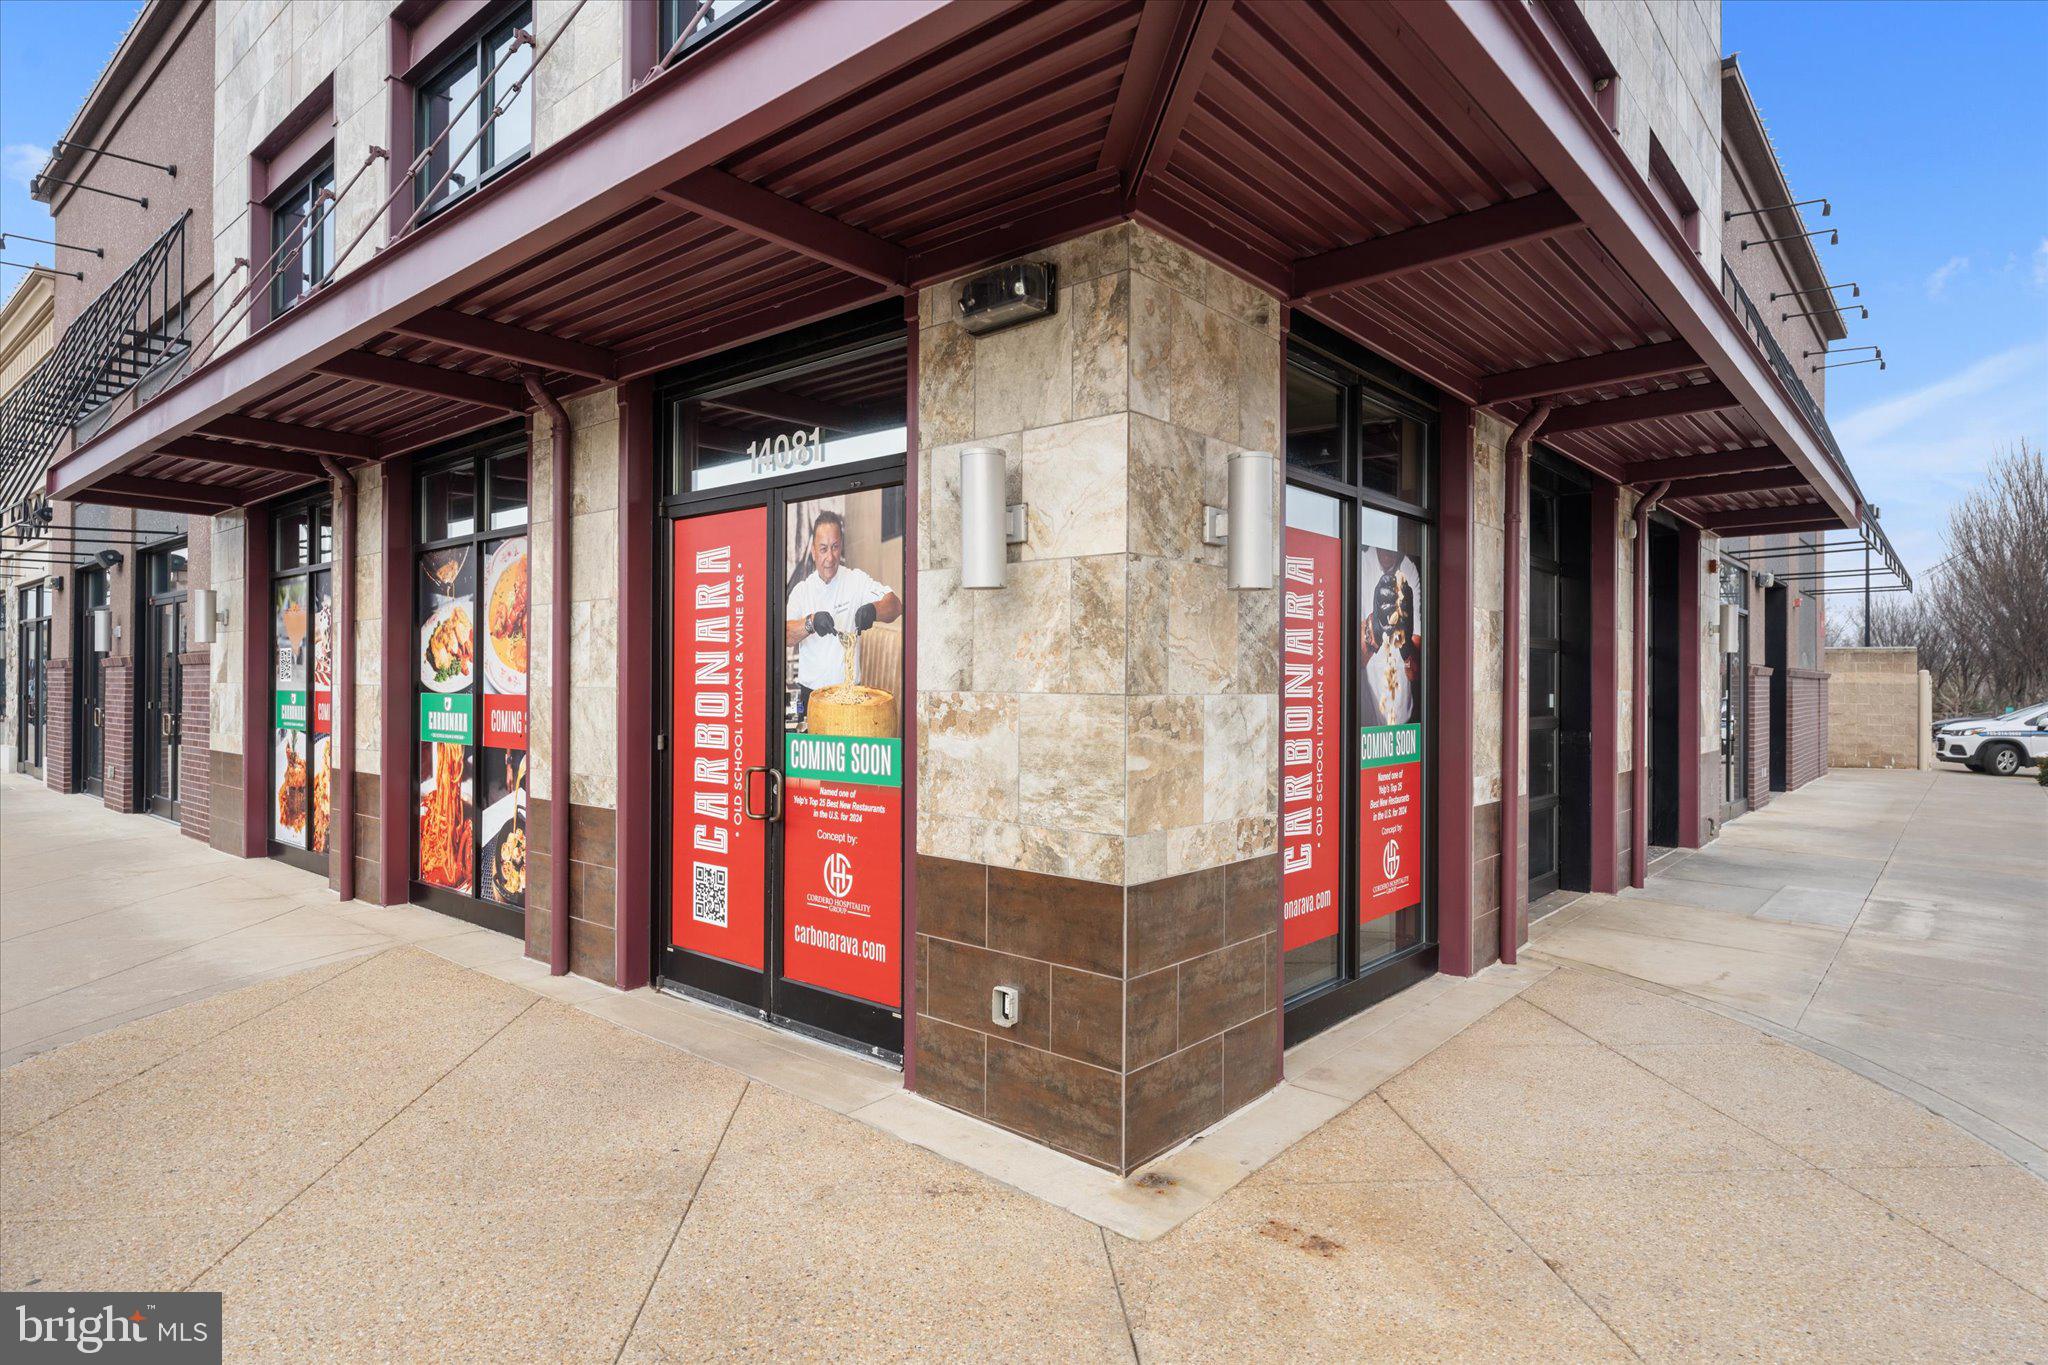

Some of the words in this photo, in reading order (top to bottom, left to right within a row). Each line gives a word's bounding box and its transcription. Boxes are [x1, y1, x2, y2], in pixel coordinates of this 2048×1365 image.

[747, 427, 820, 473] 14081
[736, 574, 744, 602] BAR
[735, 606, 744, 648] WINE
[735, 652, 744, 662] &
[1317, 666, 1324, 676] &
[694, 545, 731, 854] CARBONARA
[734, 668, 744, 722] ITALIAN
[491, 709, 522, 733] COMING
[1284, 555, 1314, 875] CARBONARA
[734, 728, 743, 790] SCHOOL
[791, 739, 845, 772] COMING
[851, 743, 891, 776] SOON
[1361, 732, 1394, 760] COMING
[1396, 730, 1416, 756] SOON
[793, 795, 808, 806] Yelp's
[809, 797, 818, 807] Top
[819, 799, 826, 807] 25
[826, 799, 839, 809] Best
[840, 801, 851, 810] New
[852, 802, 886, 814] Restaurants
[820, 787, 838, 797] Named
[839, 790, 849, 798] one
[850, 790, 857, 799] of
[734, 795, 743, 825] OLD
[813, 809, 819, 818] in
[820, 810, 828, 819] the
[828, 811, 840, 820] U.S.
[841, 812, 849, 821] for
[849, 813, 863, 823] 2024
[816, 829, 846, 843] Concept
[847, 834, 859, 846] by:
[806, 894, 834, 906] CORDERO
[834, 899, 871, 913] HOSPITALITY
[794, 924, 886, 963] carbonarava.com
